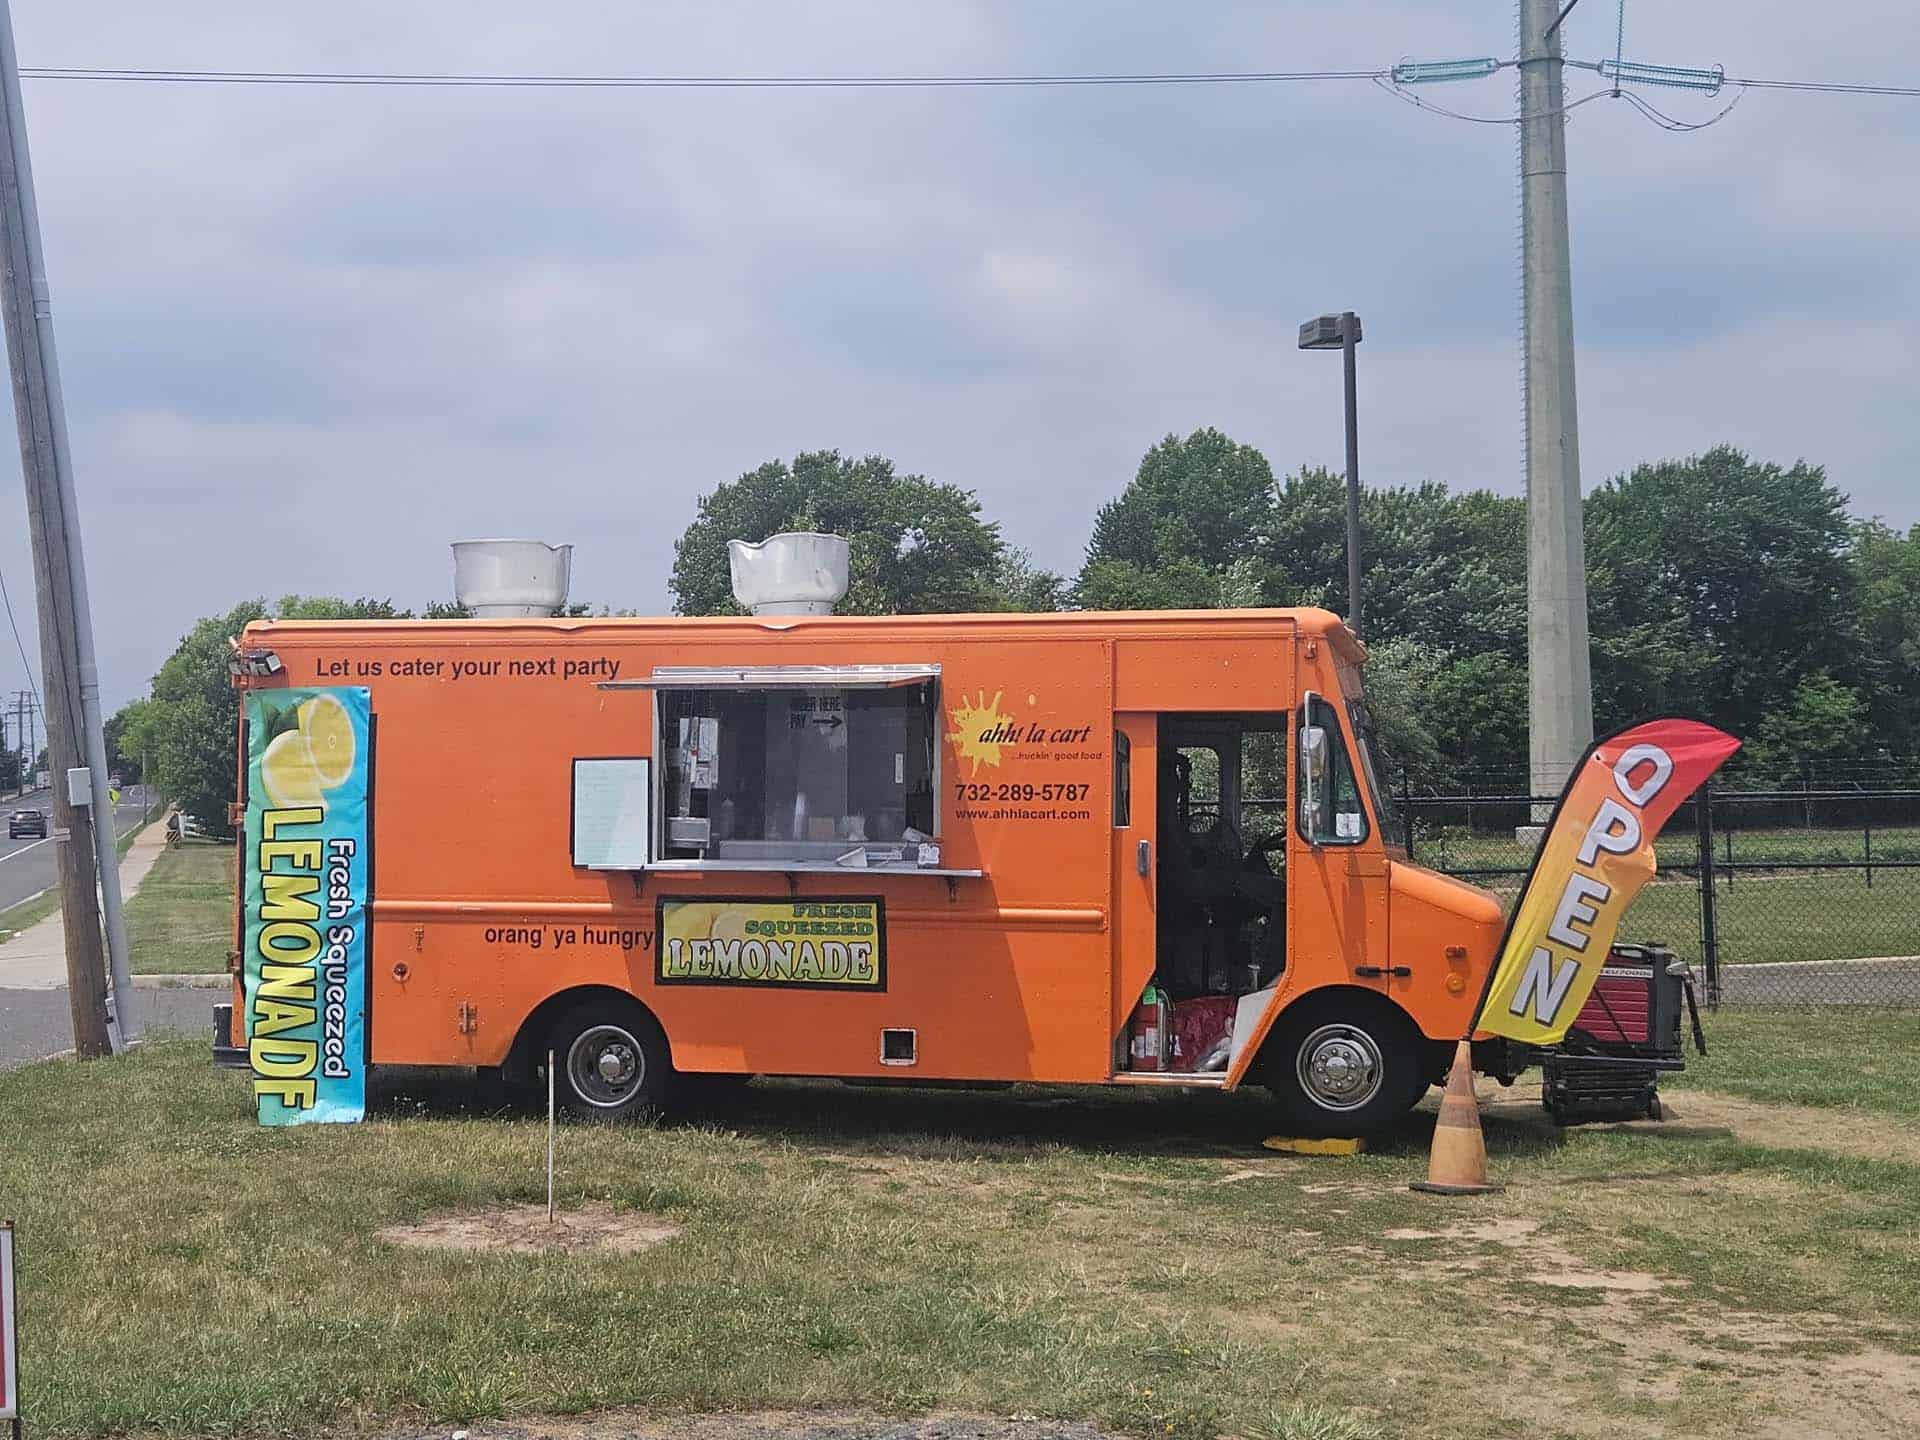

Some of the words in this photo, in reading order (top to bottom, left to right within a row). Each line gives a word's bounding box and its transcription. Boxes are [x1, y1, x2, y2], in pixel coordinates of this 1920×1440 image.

[317, 658, 350, 677] Let
[357, 661, 382, 677] us
[389, 659, 444, 677] cater
[451, 660, 501, 681] your
[508, 659, 556, 677] next
[563, 659, 620, 681] party
[979, 722, 1024, 743] ahh!
[1025, 722, 1046, 743] la
[1050, 725, 1092, 743] cart
[1054, 751, 1080, 761] good
[1081, 751, 1103, 760] food
[955, 783, 1090, 801] 732-289-5787
[955, 808, 1090, 820] www.ahhlacart.com
[328, 838, 355, 919] Fresh
[1510, 743, 1676, 1028] OPEN
[792, 904, 873, 919] FRESH
[484, 925, 547, 949] orang'
[554, 929, 577, 949] ya
[583, 925, 654, 950] hungry
[744, 920, 875, 937] SQUEEZED
[668, 937, 875, 981] LEMONADE
[320, 925, 355, 1079] Squeezed
